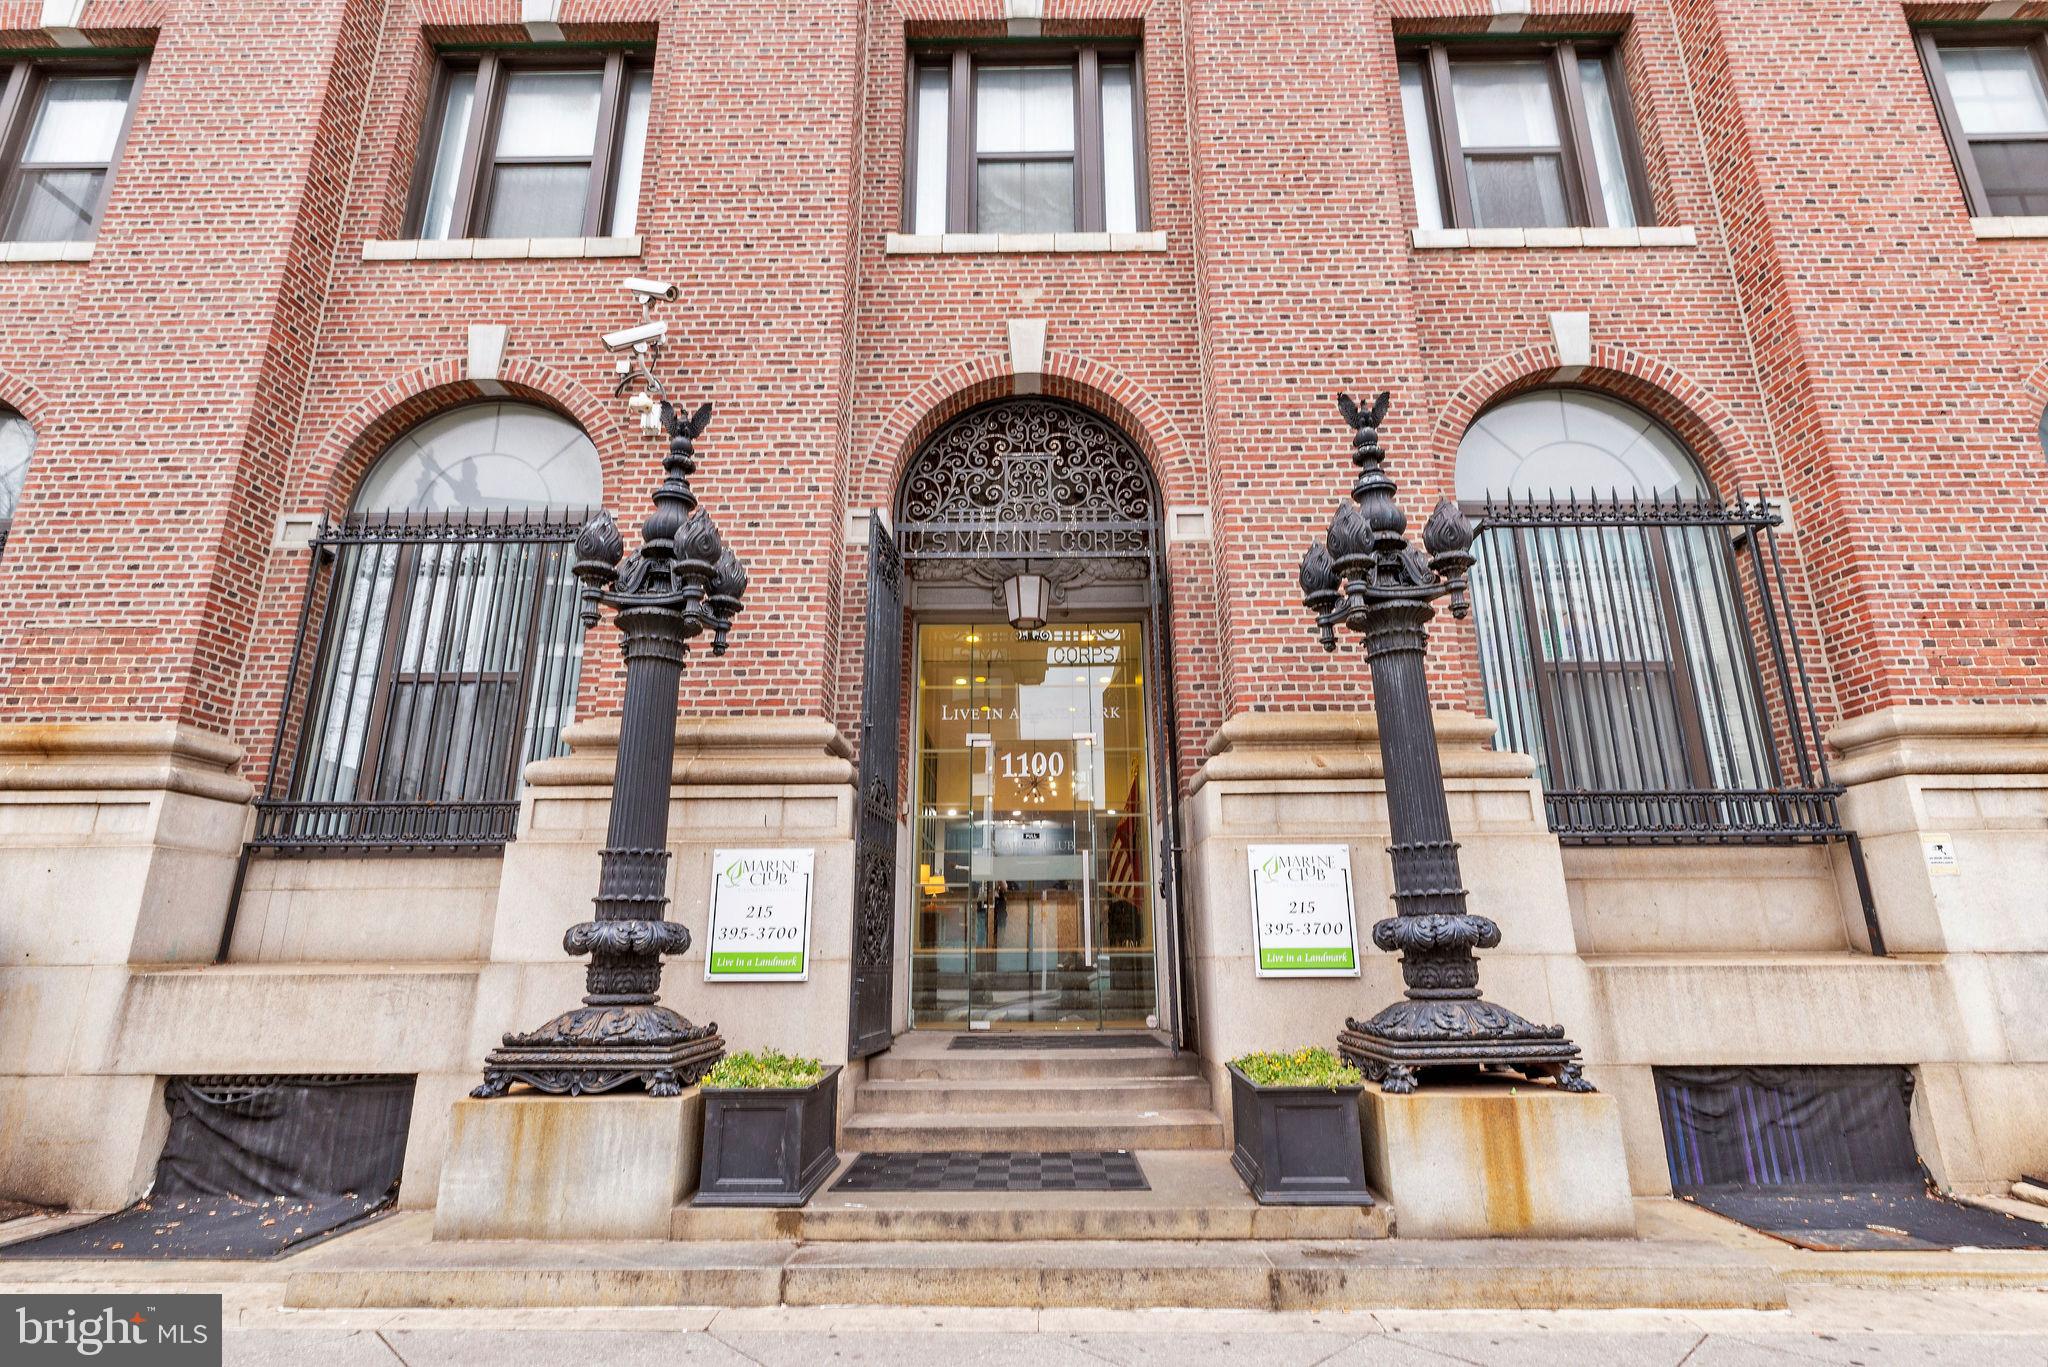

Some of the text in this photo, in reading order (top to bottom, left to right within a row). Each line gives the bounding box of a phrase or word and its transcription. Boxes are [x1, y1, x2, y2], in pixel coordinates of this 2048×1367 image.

[955, 529, 1051, 552] MARINE
[1060, 530, 1143, 551] CORPS
[1054, 647, 1115, 664] CORPS
[1000, 751, 1064, 778] 1100
[743, 859, 799, 873] MARINE
[1279, 855, 1336, 869] MARINE
[749, 871, 788, 886] CLUB
[1287, 866, 1326, 881] CLUB
[745, 905, 773, 919] 215
[1289, 901, 1316, 914] 215
[718, 926, 798, 940] 395-3700
[1264, 922, 1343, 936] 395-3700
[716, 955, 798, 967] Live in a Landmark
[1266, 951, 1348, 963] Live in a Landmark
